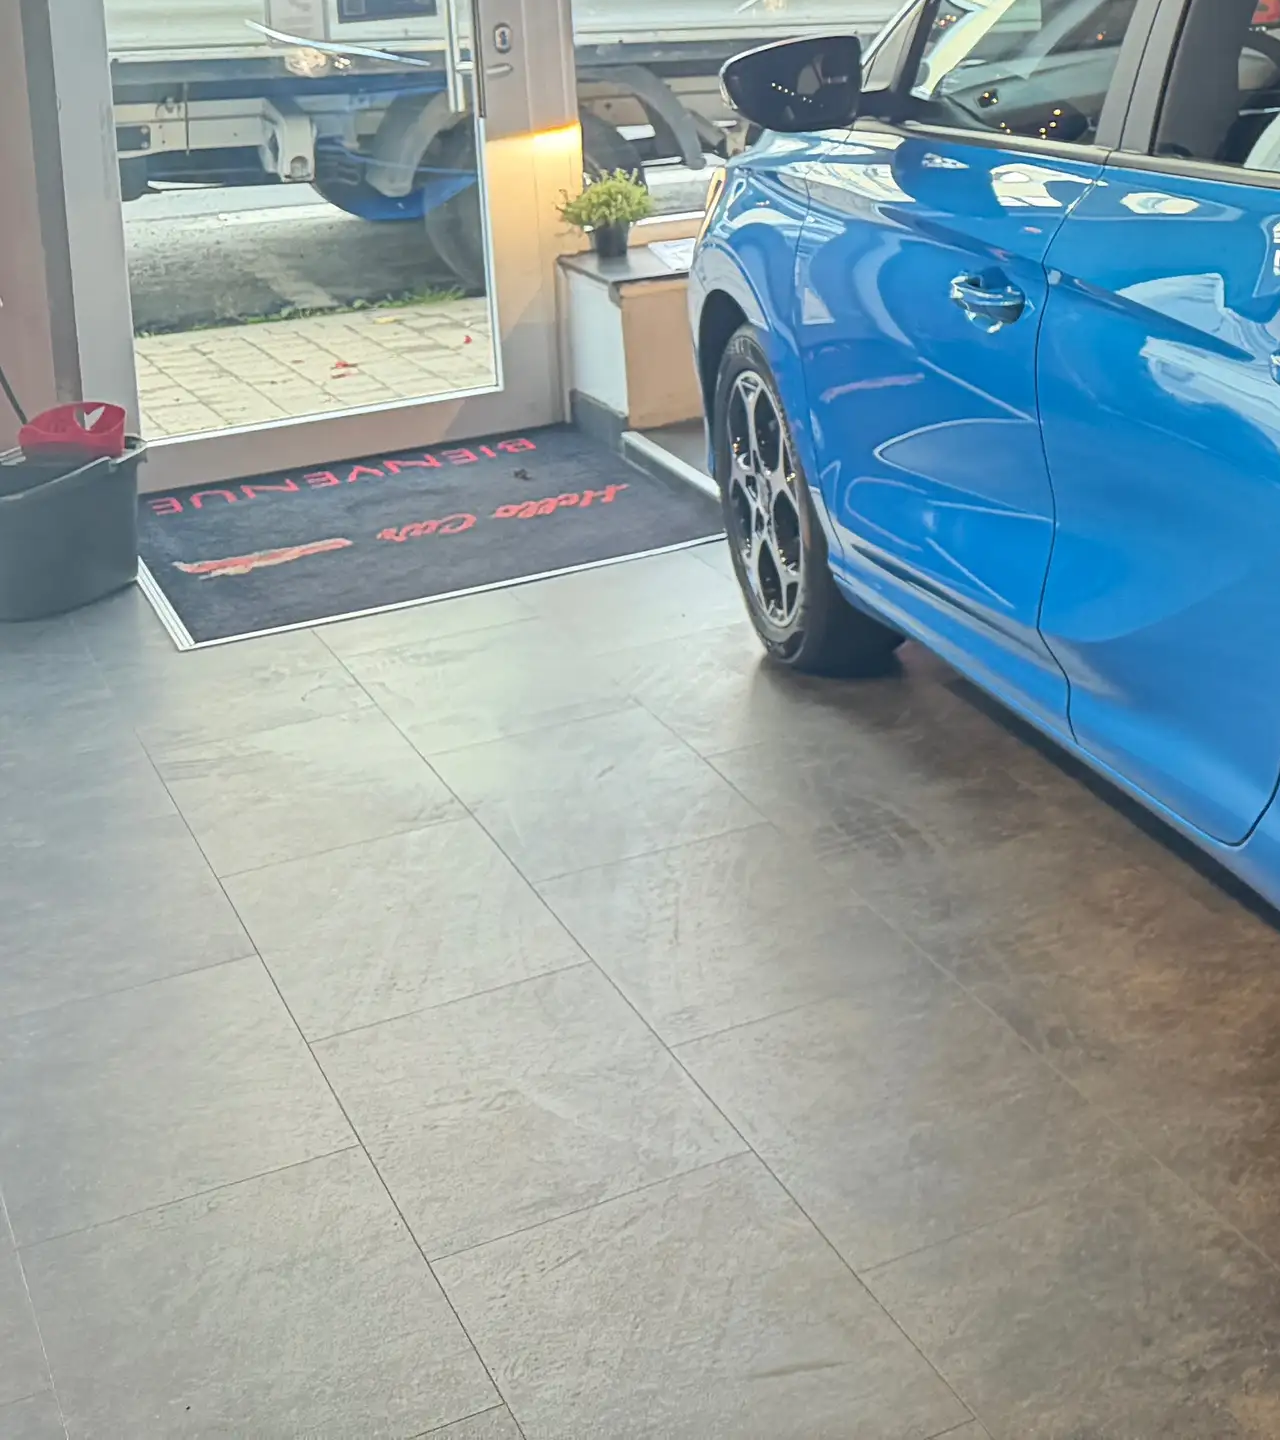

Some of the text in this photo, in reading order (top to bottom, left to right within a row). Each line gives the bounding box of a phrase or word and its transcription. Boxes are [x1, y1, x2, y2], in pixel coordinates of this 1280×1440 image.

[147, 437, 537, 517] BIENVENUE
[376, 482, 630, 543] Hello Car
